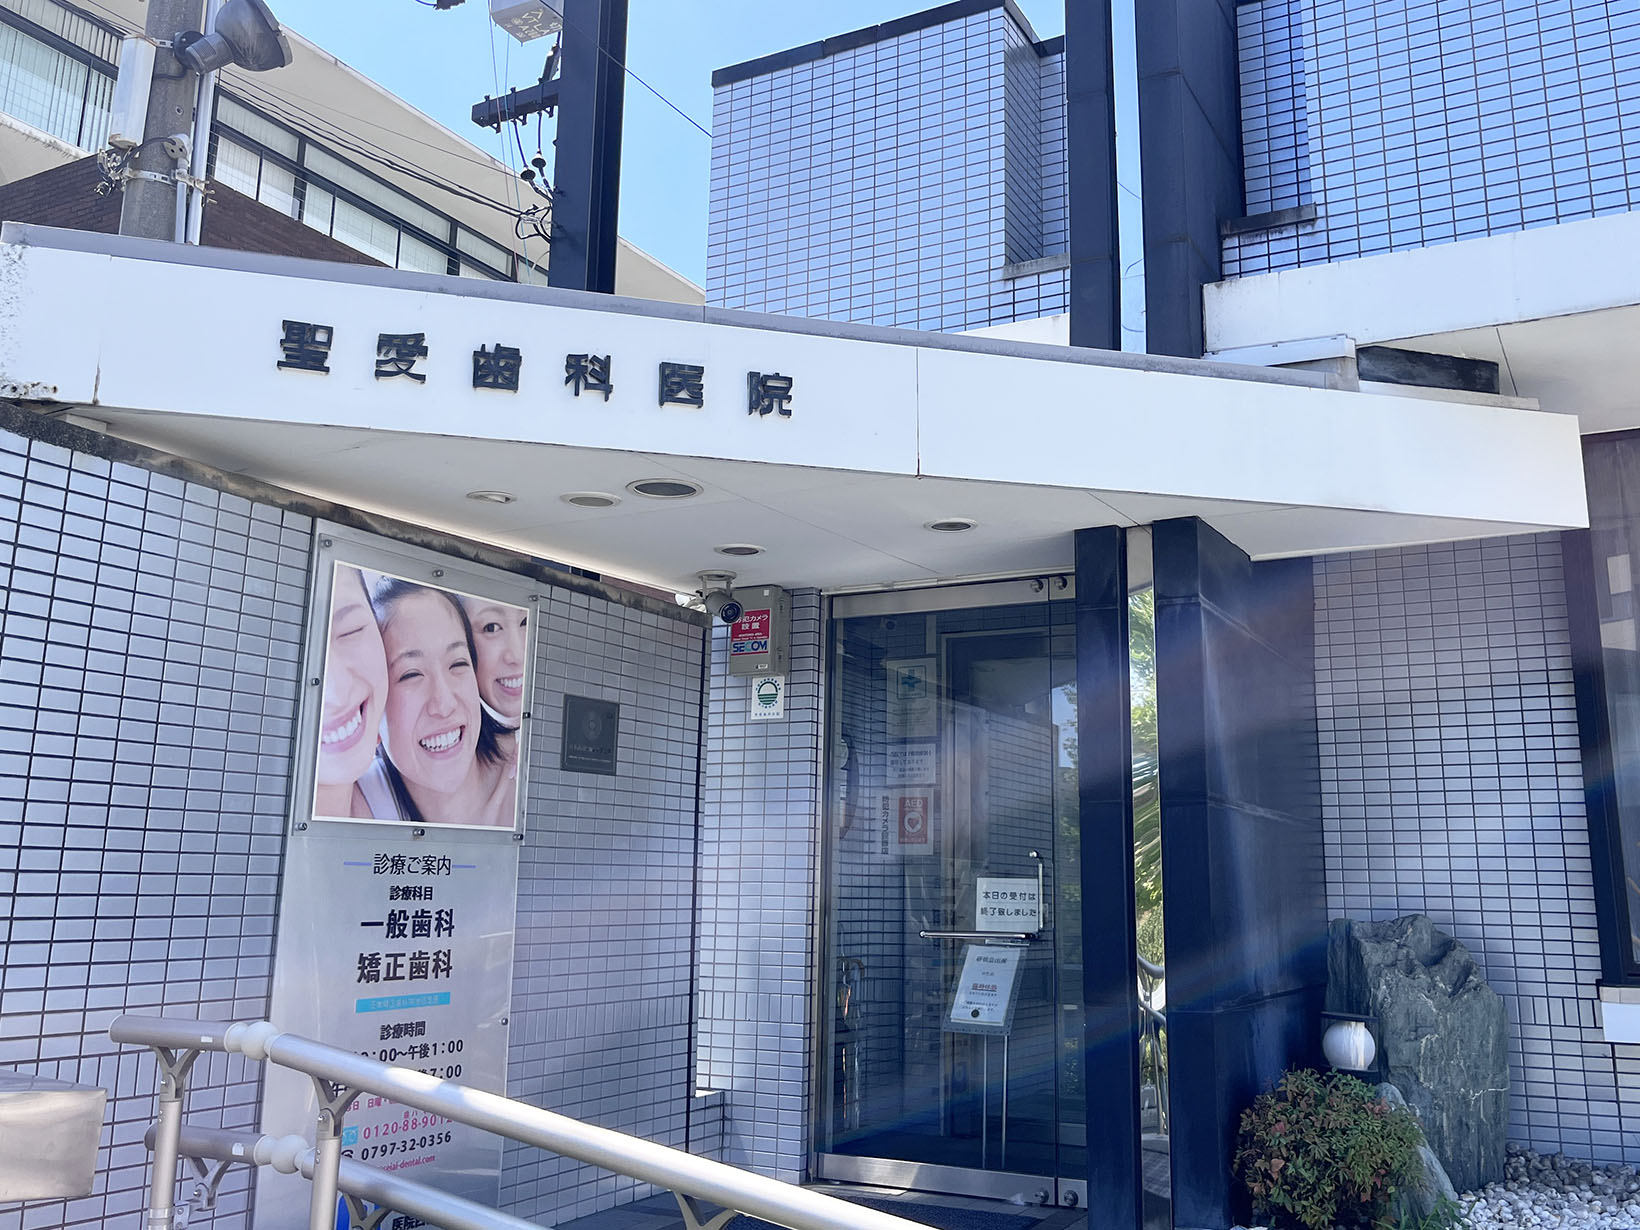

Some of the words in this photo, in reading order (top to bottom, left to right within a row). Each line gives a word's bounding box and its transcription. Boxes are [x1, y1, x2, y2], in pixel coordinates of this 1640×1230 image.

[276, 319, 794, 418] 聖愛歯科医院
[732, 640, 768, 653] SECOM
[904, 800, 923, 808] AED
[373, 853, 451, 876] 診療ご案内
[389, 885, 433, 901] 診療科目
[982, 891, 1036, 901] 本日の受付は
[980, 906, 1037, 917] 終了致しました
[360, 908, 455, 939] 一般歯科
[357, 949, 453, 984] 矯正歯科
[380, 1020, 426, 1041] 診療時間
[361, 1131, 452, 1161] 0797-32-0356
